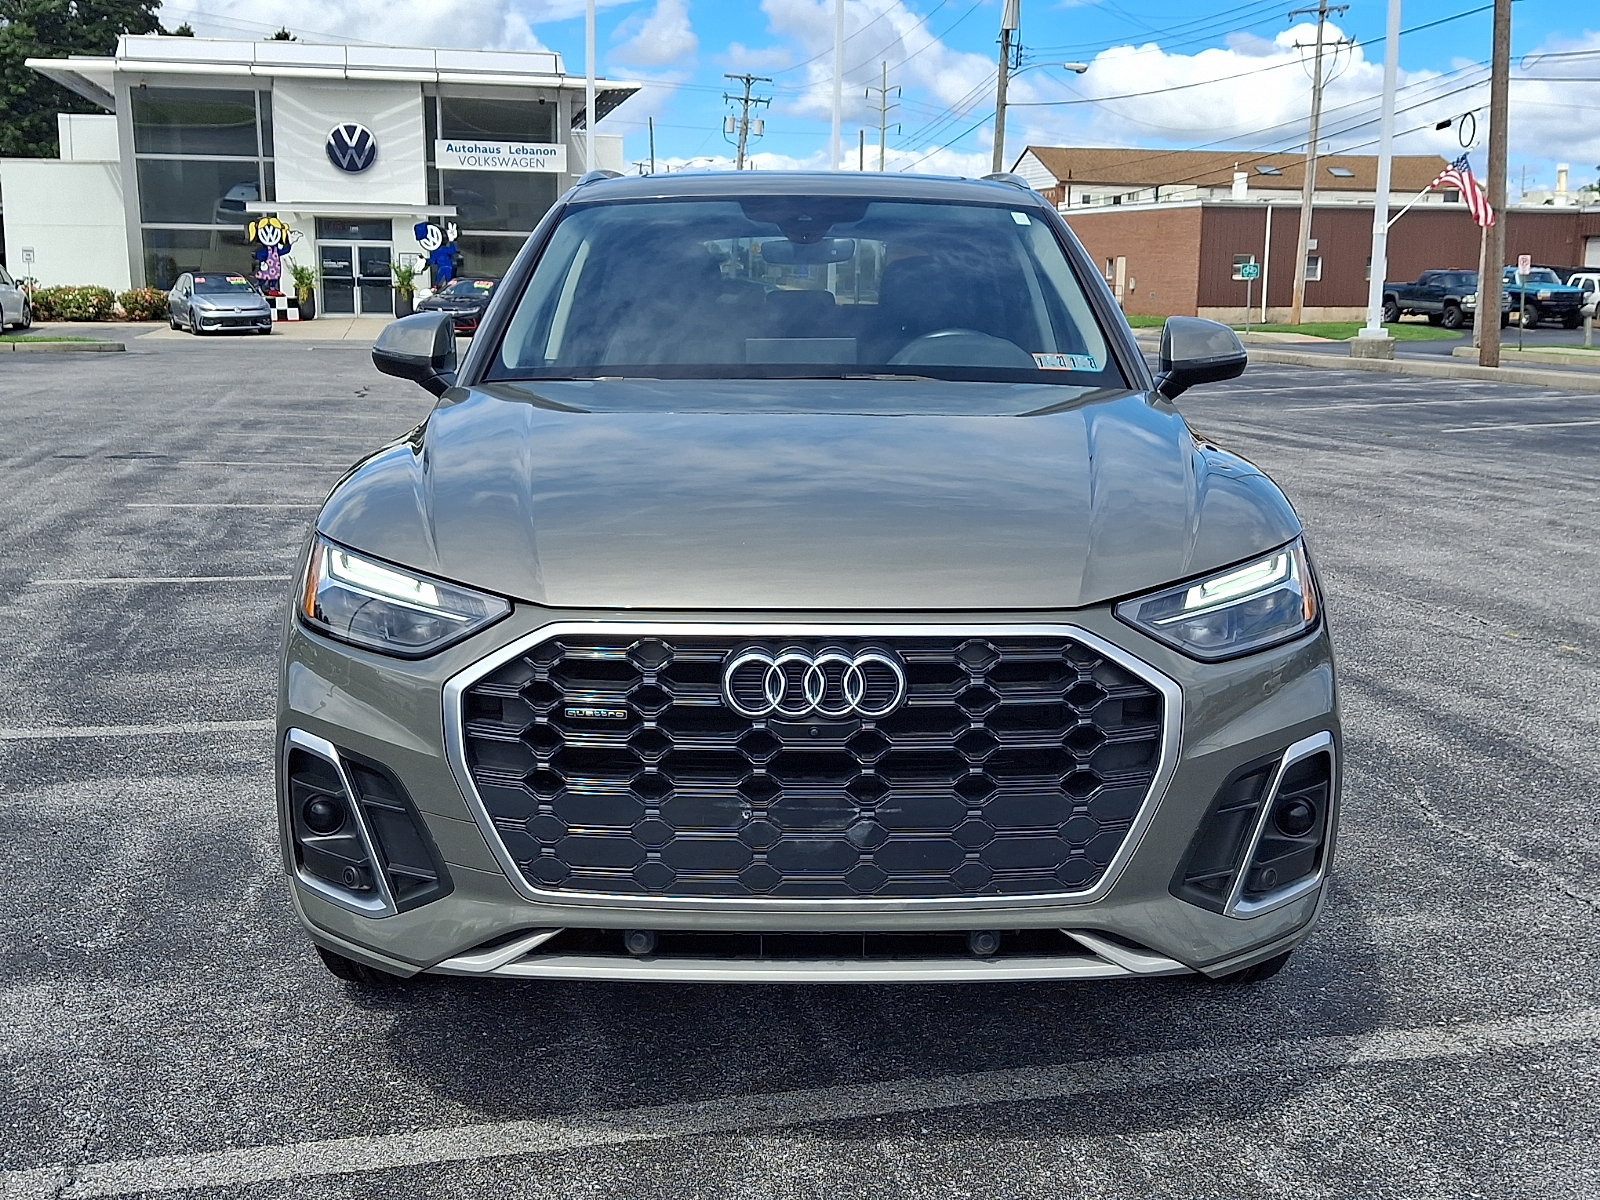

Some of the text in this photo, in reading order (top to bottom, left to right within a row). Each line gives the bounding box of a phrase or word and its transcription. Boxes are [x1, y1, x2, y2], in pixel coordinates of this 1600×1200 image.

[327, 122, 375, 170] VW
[446, 143, 557, 156] Autohaus Lebanon
[458, 155, 546, 168] VOLKSWAGEN
[567, 709, 625, 718] quattro
